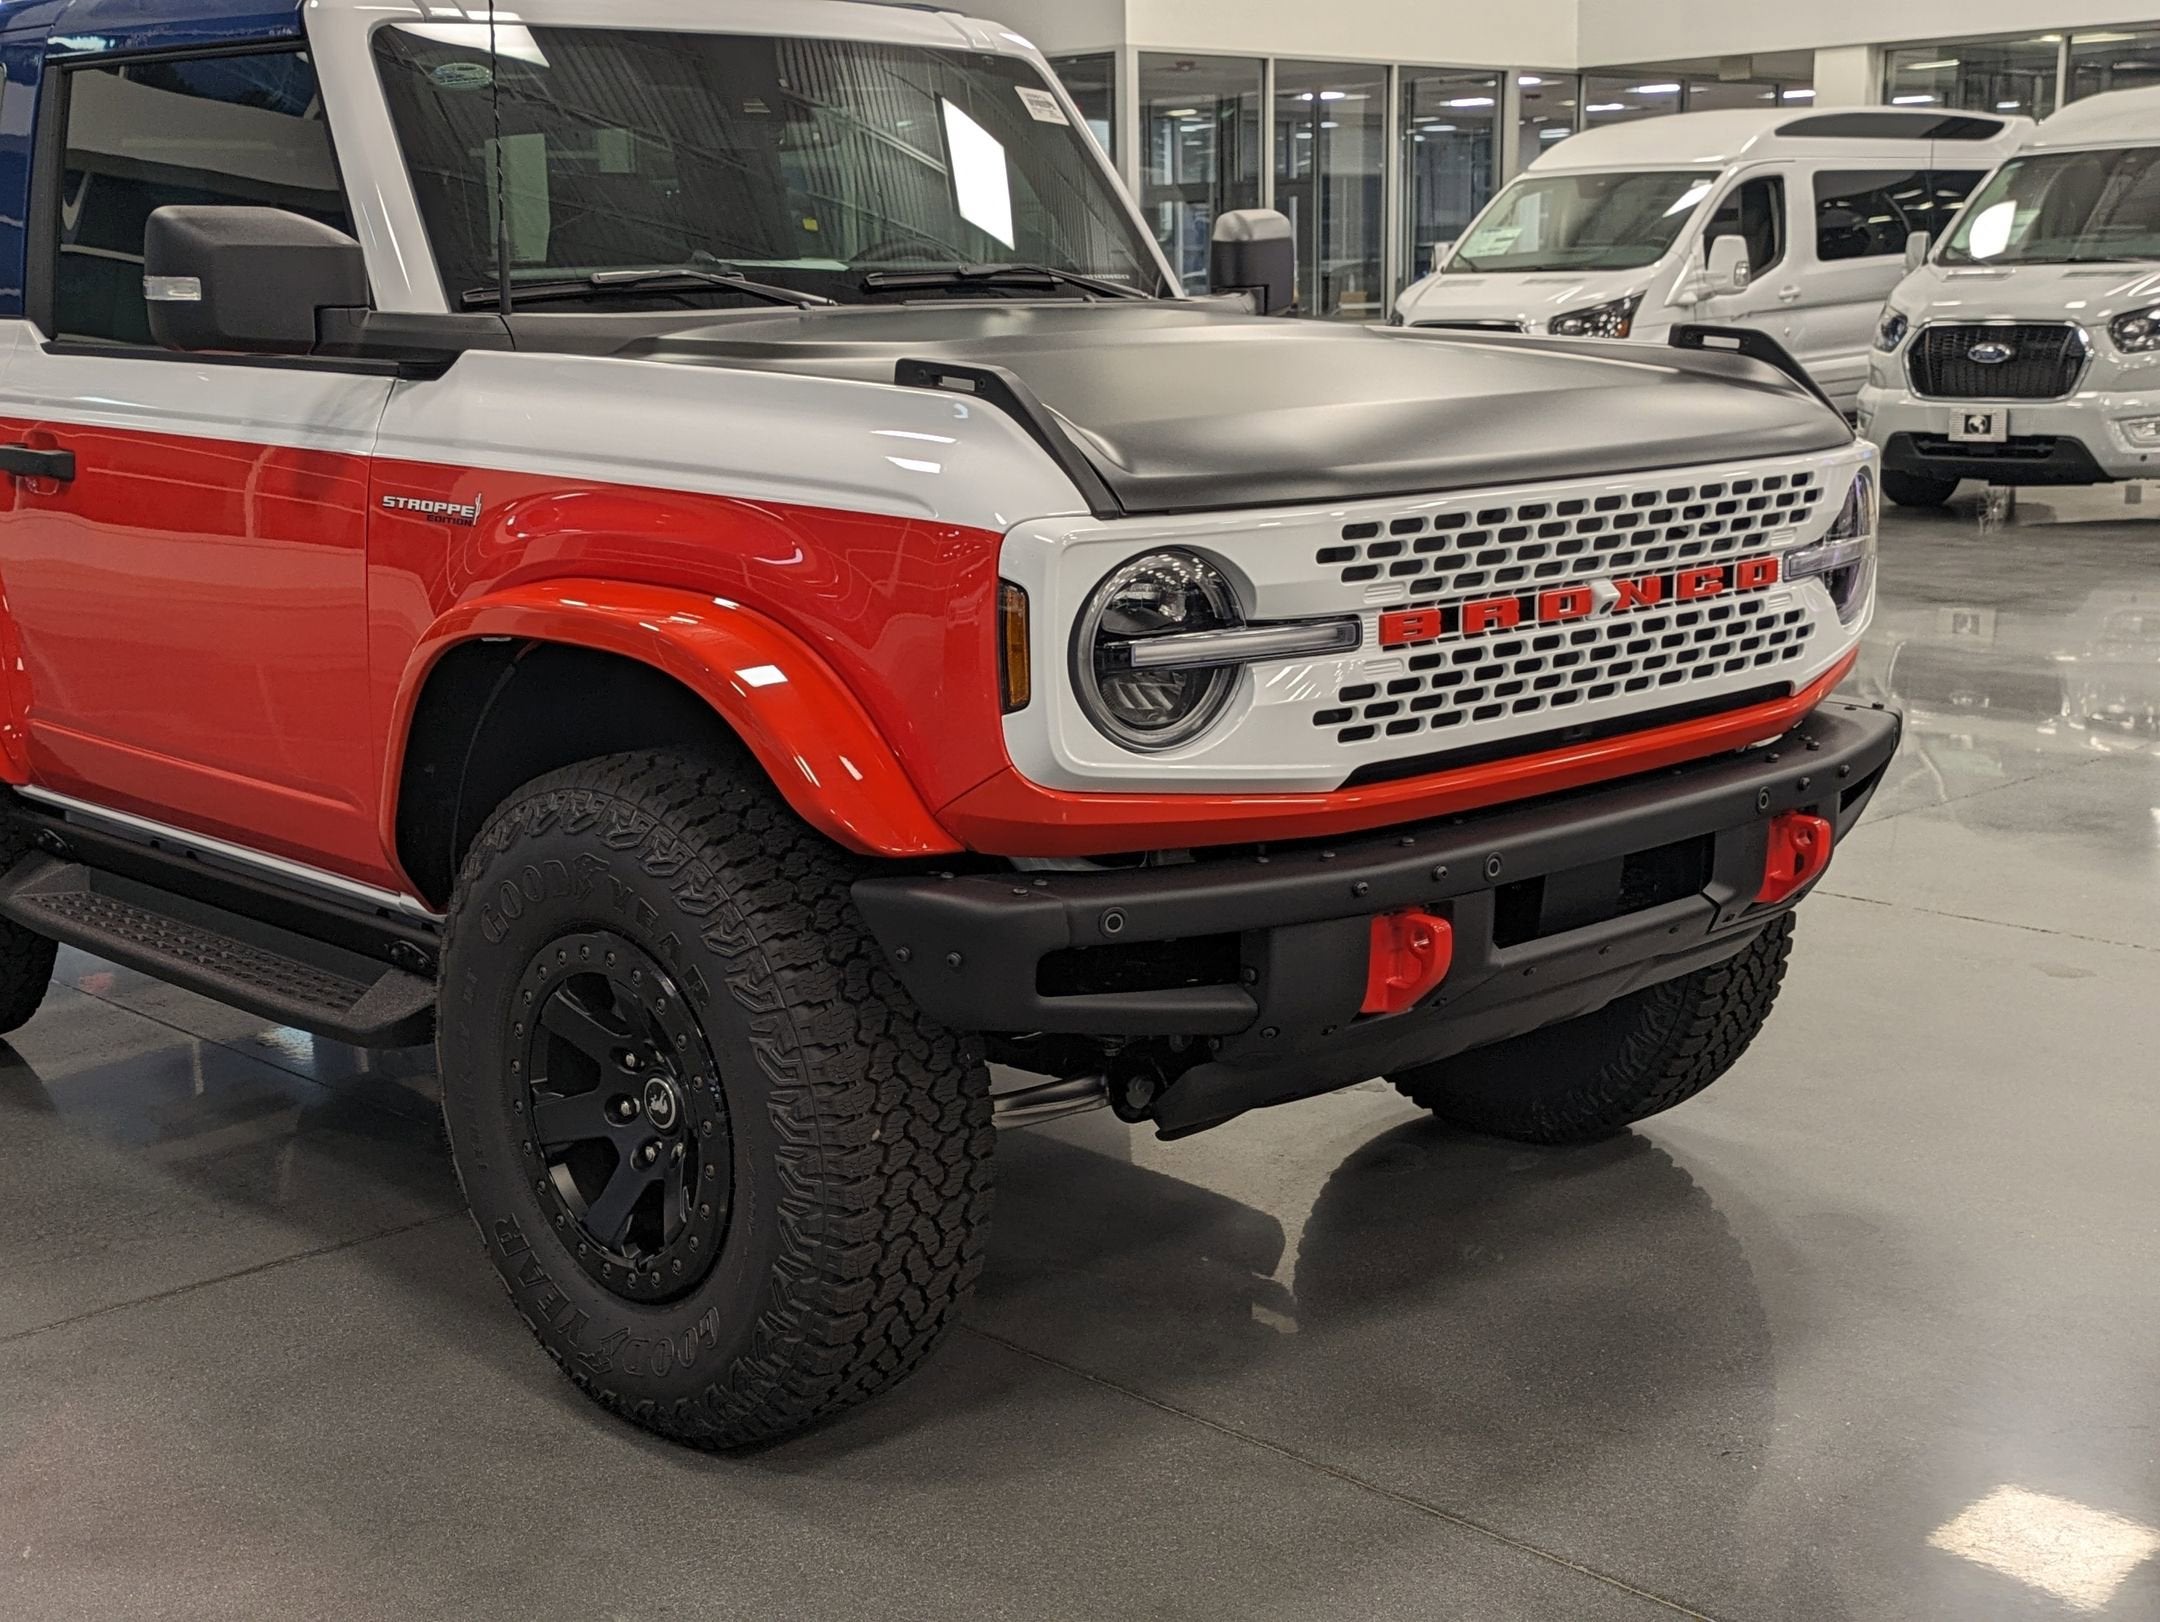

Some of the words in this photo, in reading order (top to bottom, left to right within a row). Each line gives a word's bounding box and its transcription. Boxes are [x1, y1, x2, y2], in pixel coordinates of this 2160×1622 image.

[382, 496, 475, 518] STROPPE
[426, 514, 473, 527] EDITION
[1379, 556, 1778, 646] BRONCO
